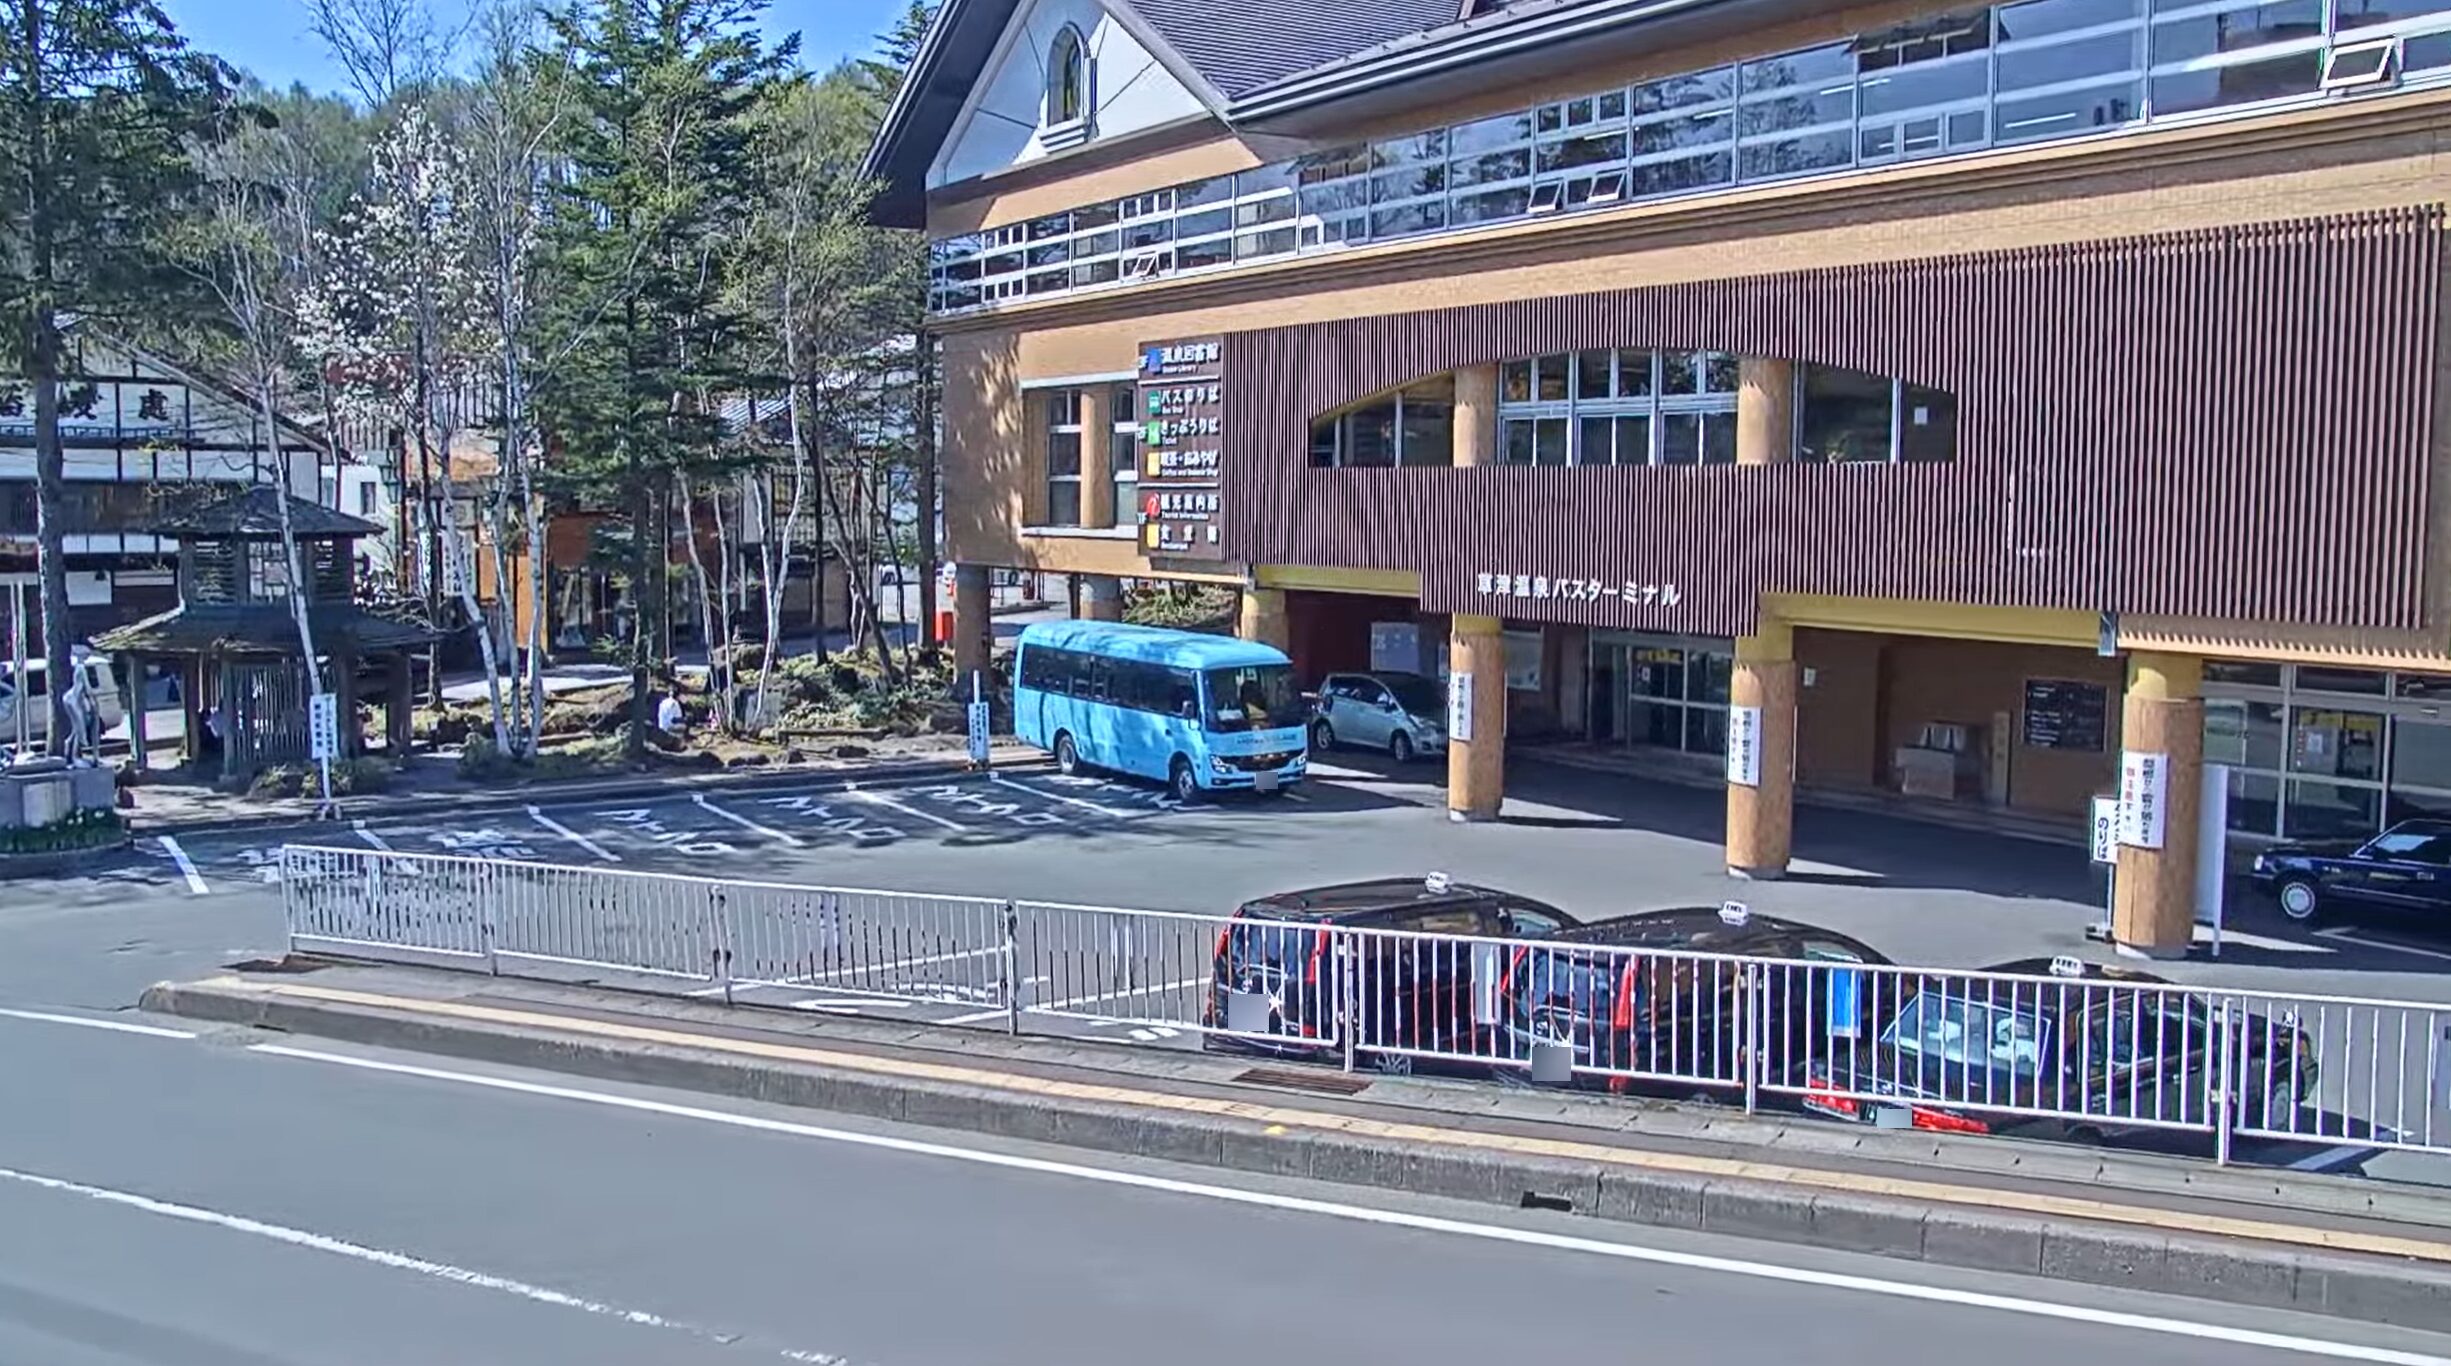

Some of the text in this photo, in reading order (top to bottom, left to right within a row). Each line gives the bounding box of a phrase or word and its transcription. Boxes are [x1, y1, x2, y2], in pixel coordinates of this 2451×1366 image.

[1161, 385, 1218, 404] バスのりば
[1161, 416, 1218, 434] きっぷうりば
[1477, 573, 1681, 606] 草津温泉バスターミナル
[2097, 817, 2109, 860] のりば
